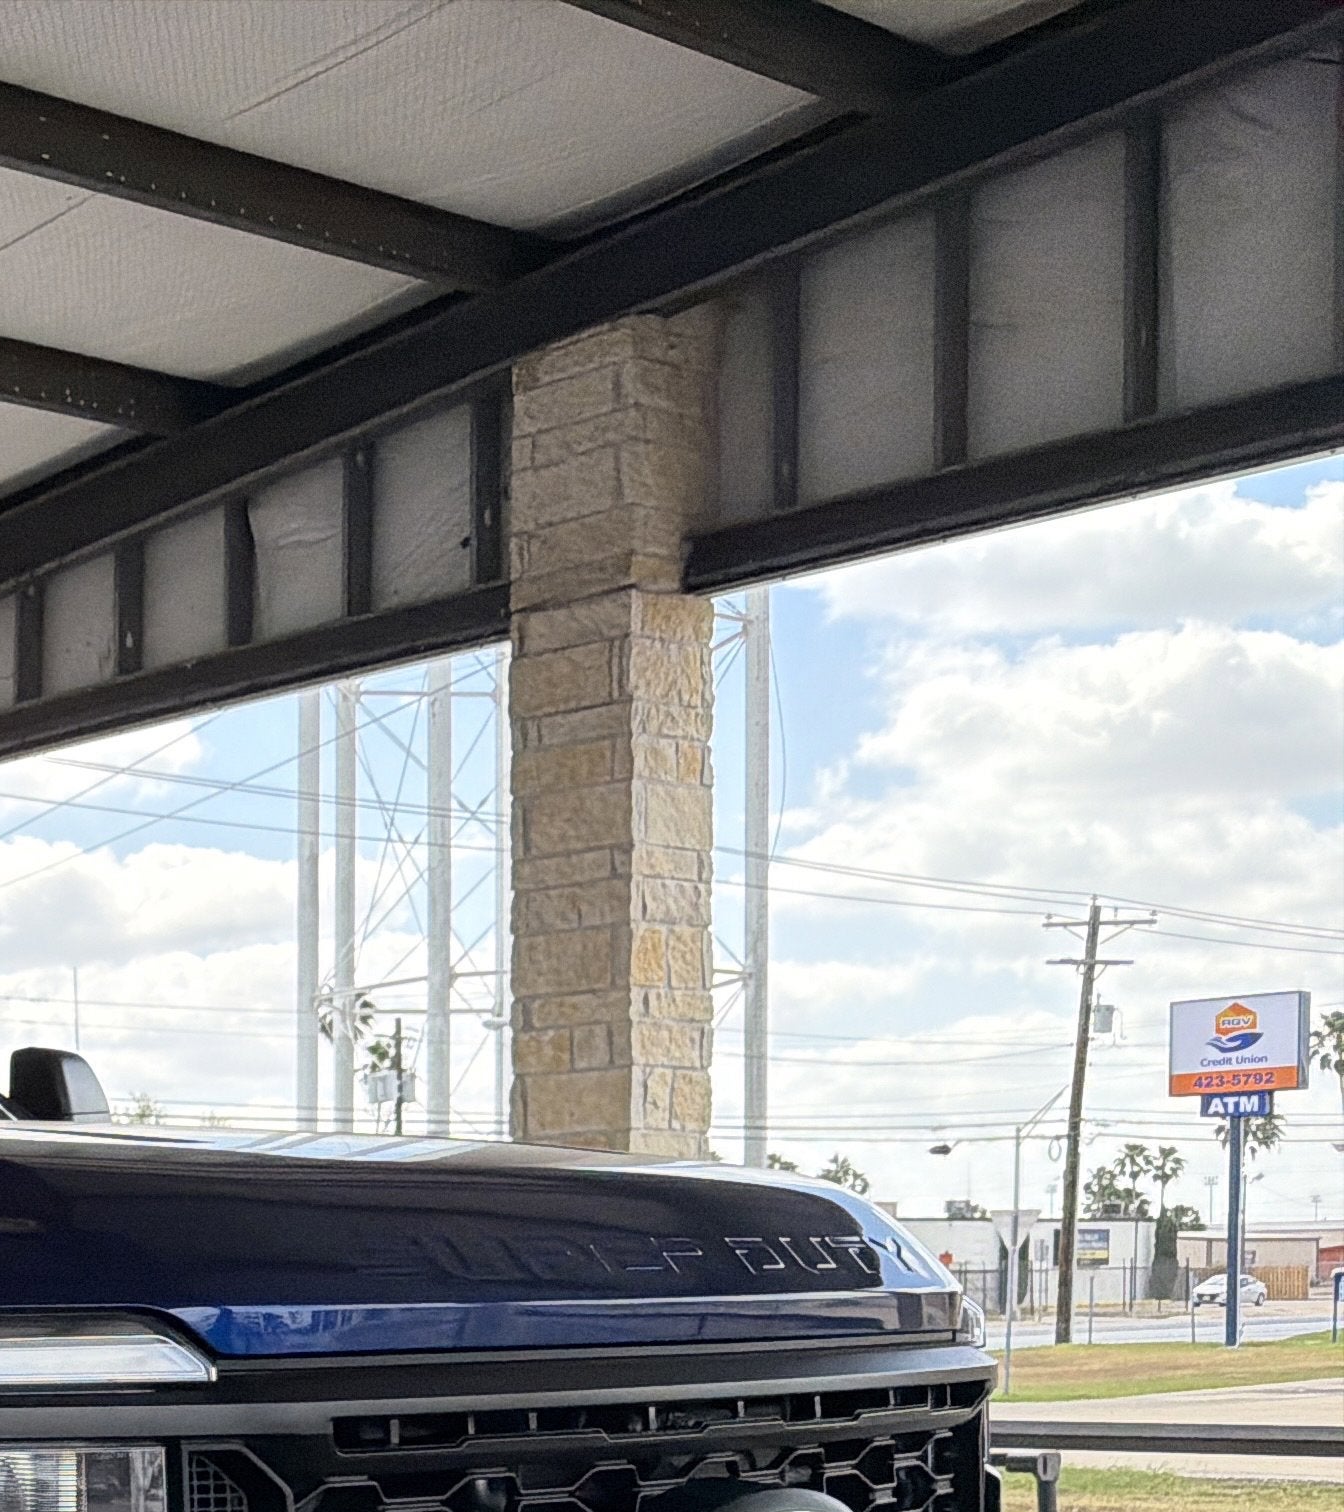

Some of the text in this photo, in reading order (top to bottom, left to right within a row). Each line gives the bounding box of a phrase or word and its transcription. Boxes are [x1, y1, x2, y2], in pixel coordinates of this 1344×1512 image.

[1200, 1055, 1269, 1068] Credit Union
[1193, 1072, 1275, 1089] 423-5792
[1207, 1095, 1259, 1115] ATM
